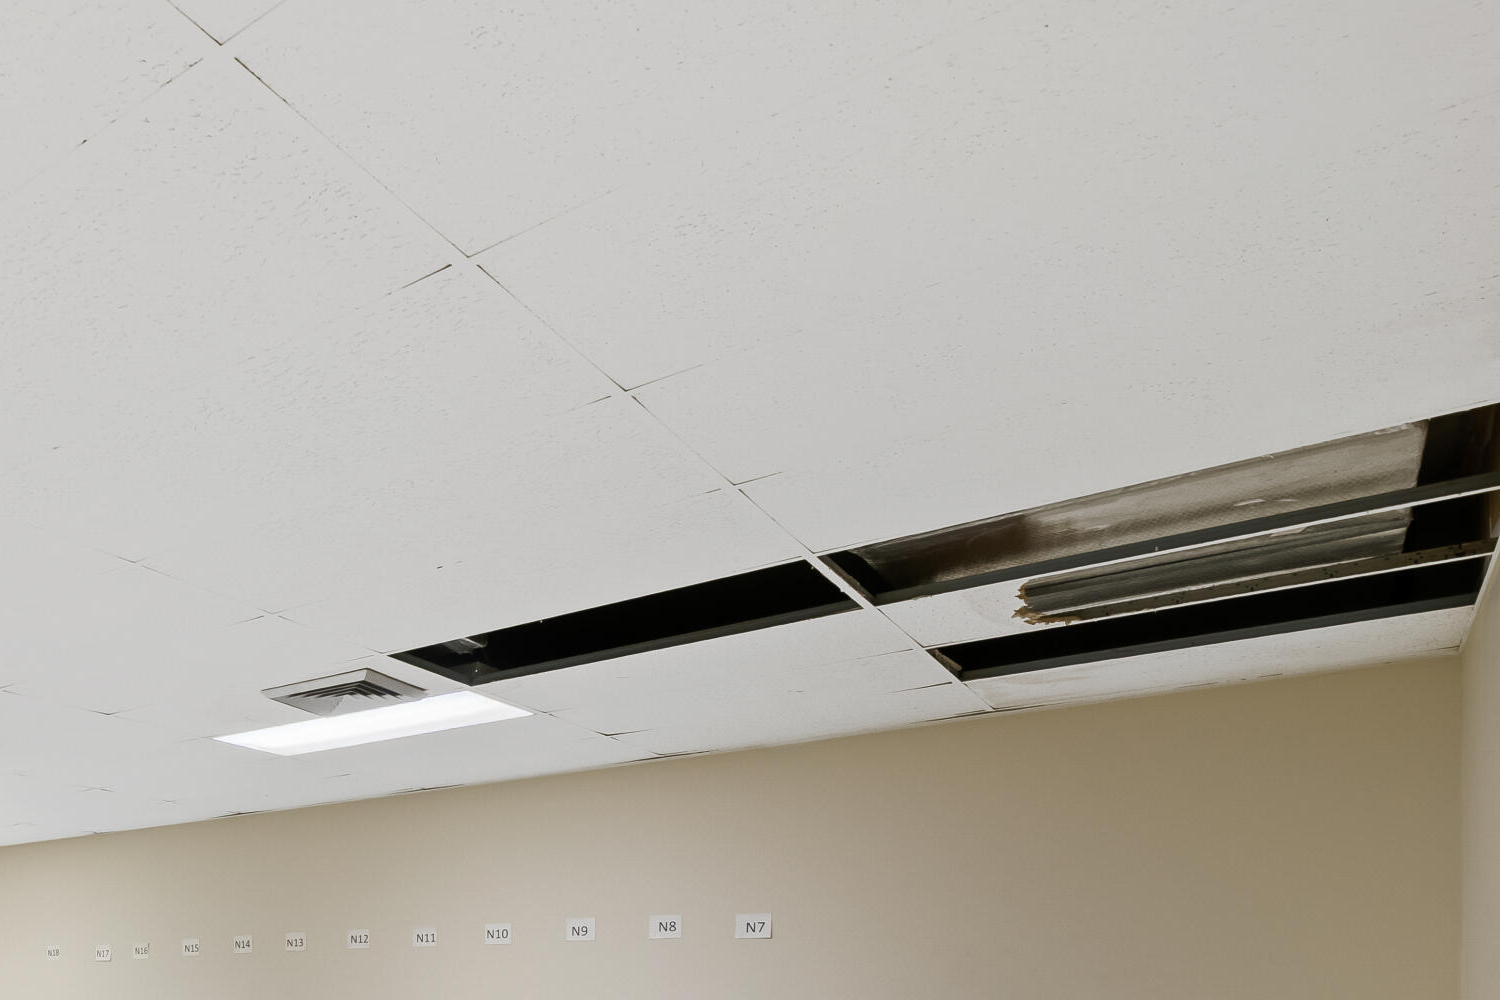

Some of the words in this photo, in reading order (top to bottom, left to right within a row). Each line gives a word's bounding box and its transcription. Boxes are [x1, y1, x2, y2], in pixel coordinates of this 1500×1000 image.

[571, 925, 588, 936] N9
[658, 921, 677, 932] N8
[746, 921, 765, 933] N7
[350, 934, 369, 944] N12
[416, 933, 436, 943] N11
[486, 929, 509, 939] N10
[235, 940, 251, 949] N14
[287, 938, 303, 947] N13
[135, 947, 148, 955] N16
[184, 943, 199, 953] N15
[48, 949, 59, 958] N18
[97, 949, 109, 958] N17
